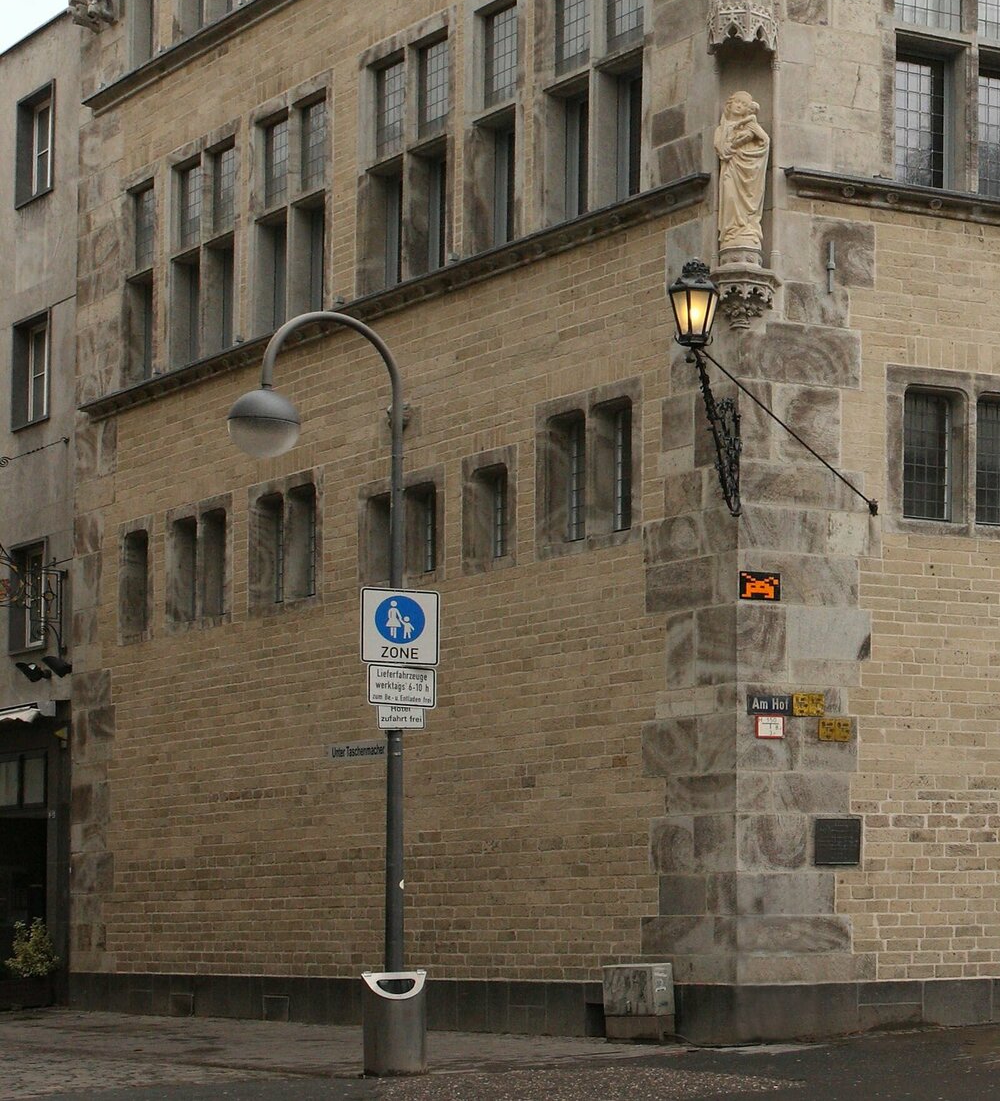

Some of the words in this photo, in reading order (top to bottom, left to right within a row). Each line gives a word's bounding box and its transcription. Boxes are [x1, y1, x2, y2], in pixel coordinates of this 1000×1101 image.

[381, 646, 419, 660] ZONE
[377, 669, 428, 683] Lieferfahrzeuge
[375, 681, 406, 692] werktags
[408, 683, 423, 692] 6-10
[425, 684, 430, 693] h
[752, 698, 768, 710] Am
[772, 698, 789, 710] Hof
[381, 715, 407, 723] zufahrt
[409, 715, 422, 723] frei
[332, 746, 346, 758] Unter
[346, 744, 385, 757] Taschenmacher
